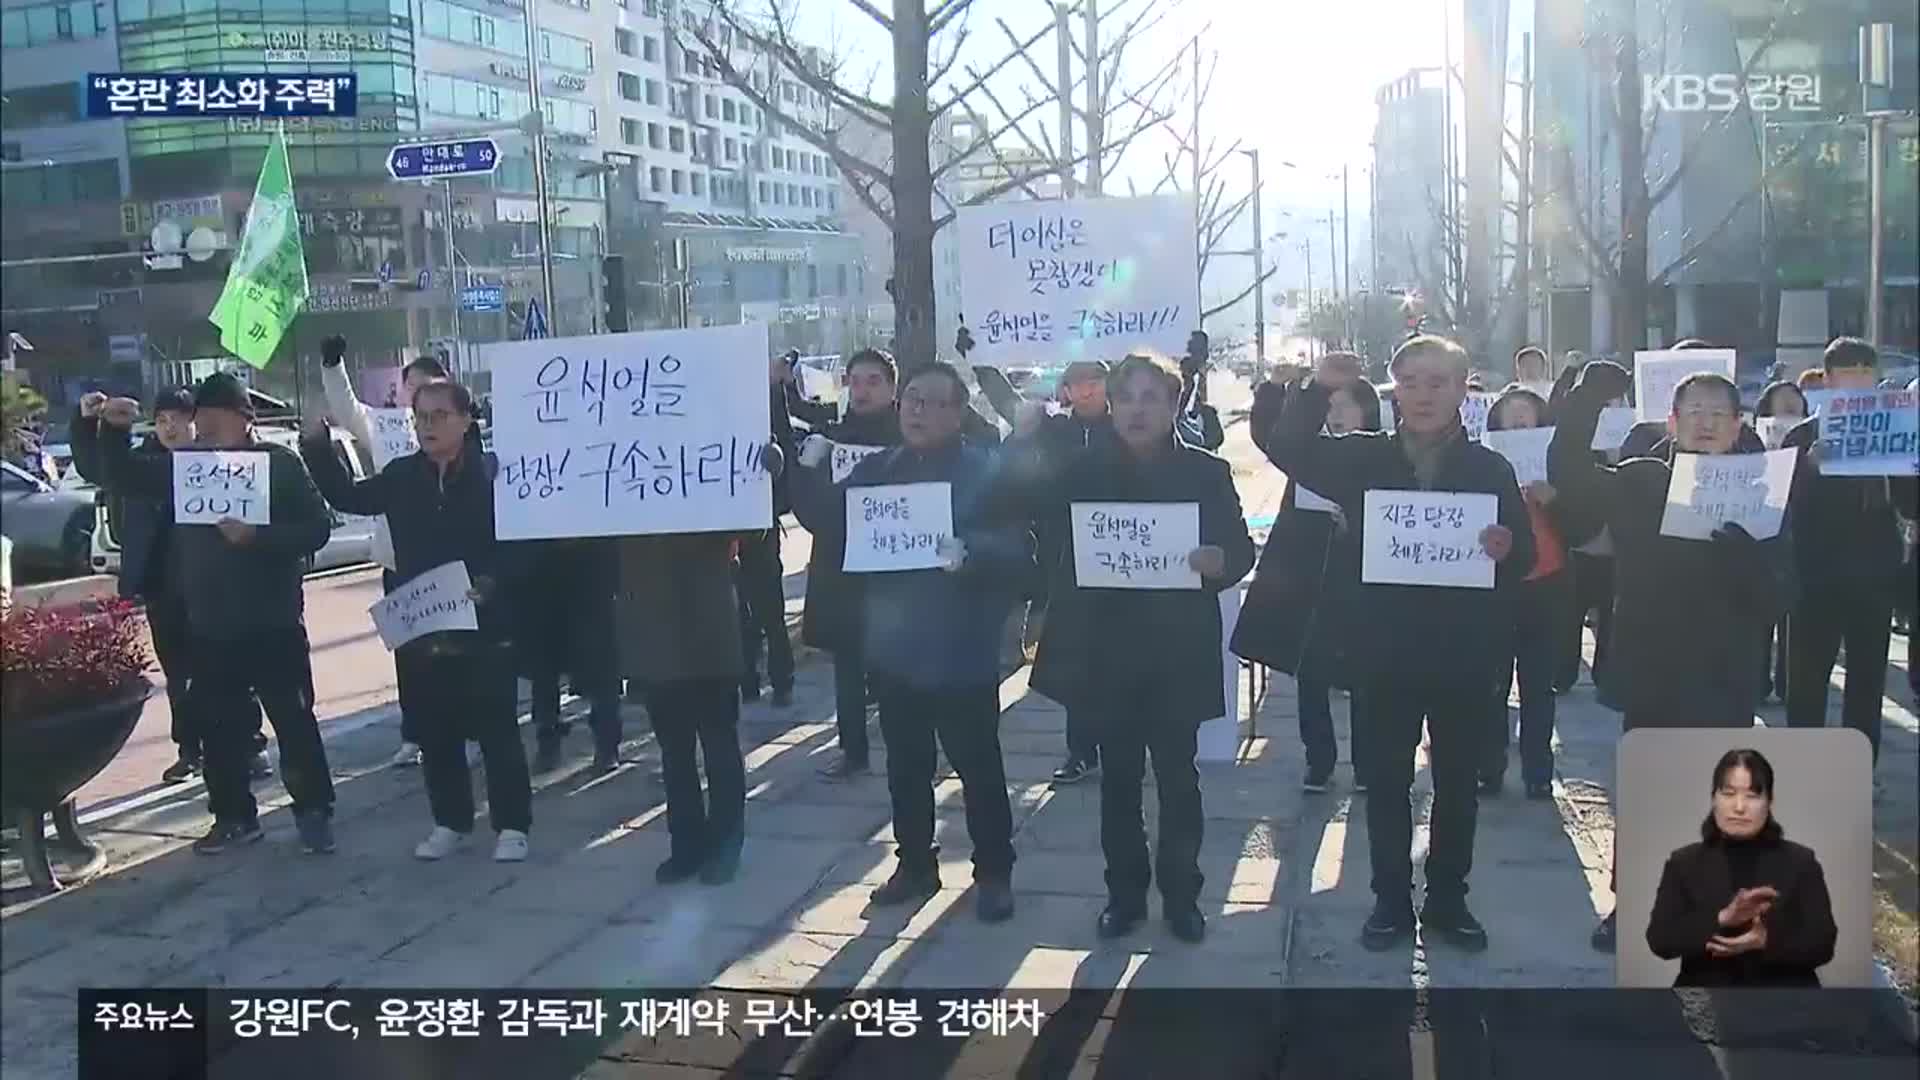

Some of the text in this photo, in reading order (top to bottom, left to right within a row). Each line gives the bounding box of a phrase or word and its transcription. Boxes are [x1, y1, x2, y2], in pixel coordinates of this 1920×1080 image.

[479, 149, 493, 162] 50
[988, 216, 1088, 258] 더 이상은
[522, 355, 686, 426] 윤석열을
[1826, 411, 1892, 435] 국민이
[185, 461, 255, 490] 윤석열
[502, 448, 571, 499] 당장!
[184, 496, 254, 519] OUT
[1379, 504, 1465, 529] 지금 당장
